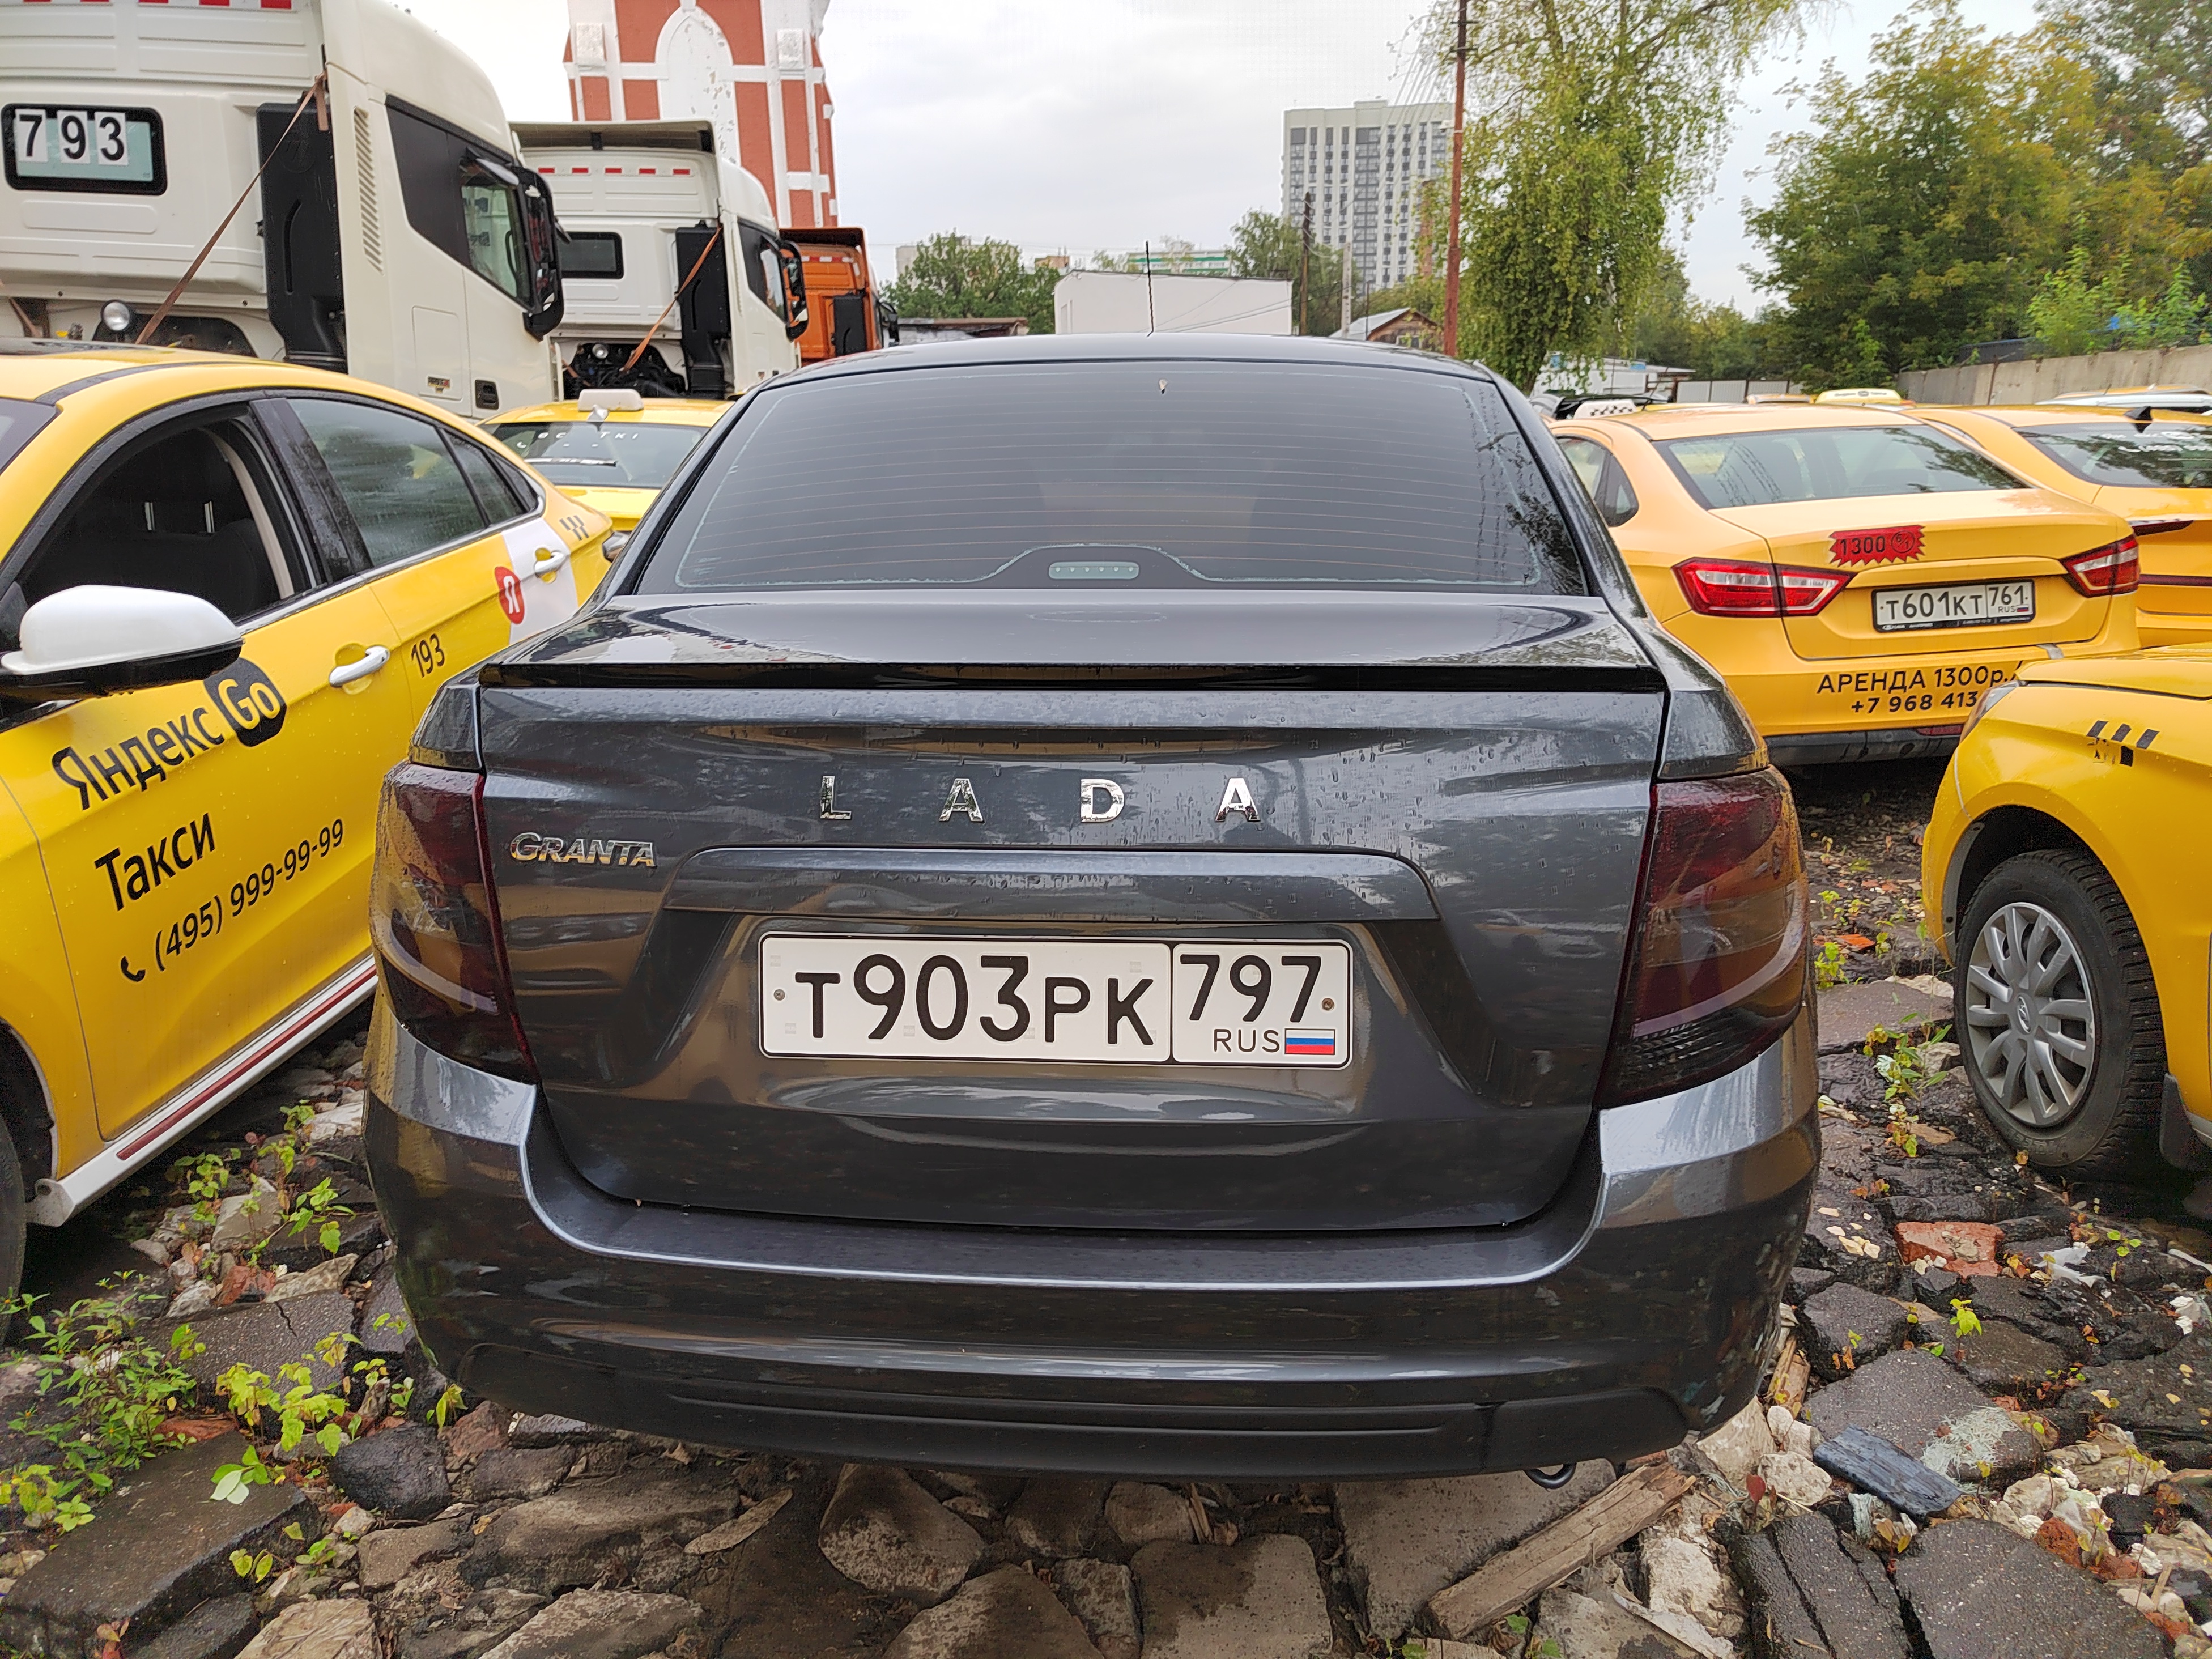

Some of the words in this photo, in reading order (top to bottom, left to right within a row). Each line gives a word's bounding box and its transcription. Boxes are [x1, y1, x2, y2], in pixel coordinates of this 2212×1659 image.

[19, 114, 125, 160] 793
[1841, 536, 1885, 556] 1300
[1989, 585, 2024, 606] 761
[411, 633, 445, 678] 193
[1817, 670, 1926, 694] АРЕНДА
[1851, 697, 1879, 713] +7
[1889, 694, 1933, 712] 968
[1941, 691, 1979, 709] 413
[52, 707, 225, 810] Яндекс
[219, 679, 280, 730] Go
[820, 775, 1261, 823] LADA
[95, 813, 215, 911] Такси
[511, 832, 657, 867] GRANTA
[155, 895, 223, 972] (495)
[231, 819, 344, 917] 999-99-99
[1179, 954, 1321, 1023] 797
[1213, 1028, 1281, 1053] RUS
